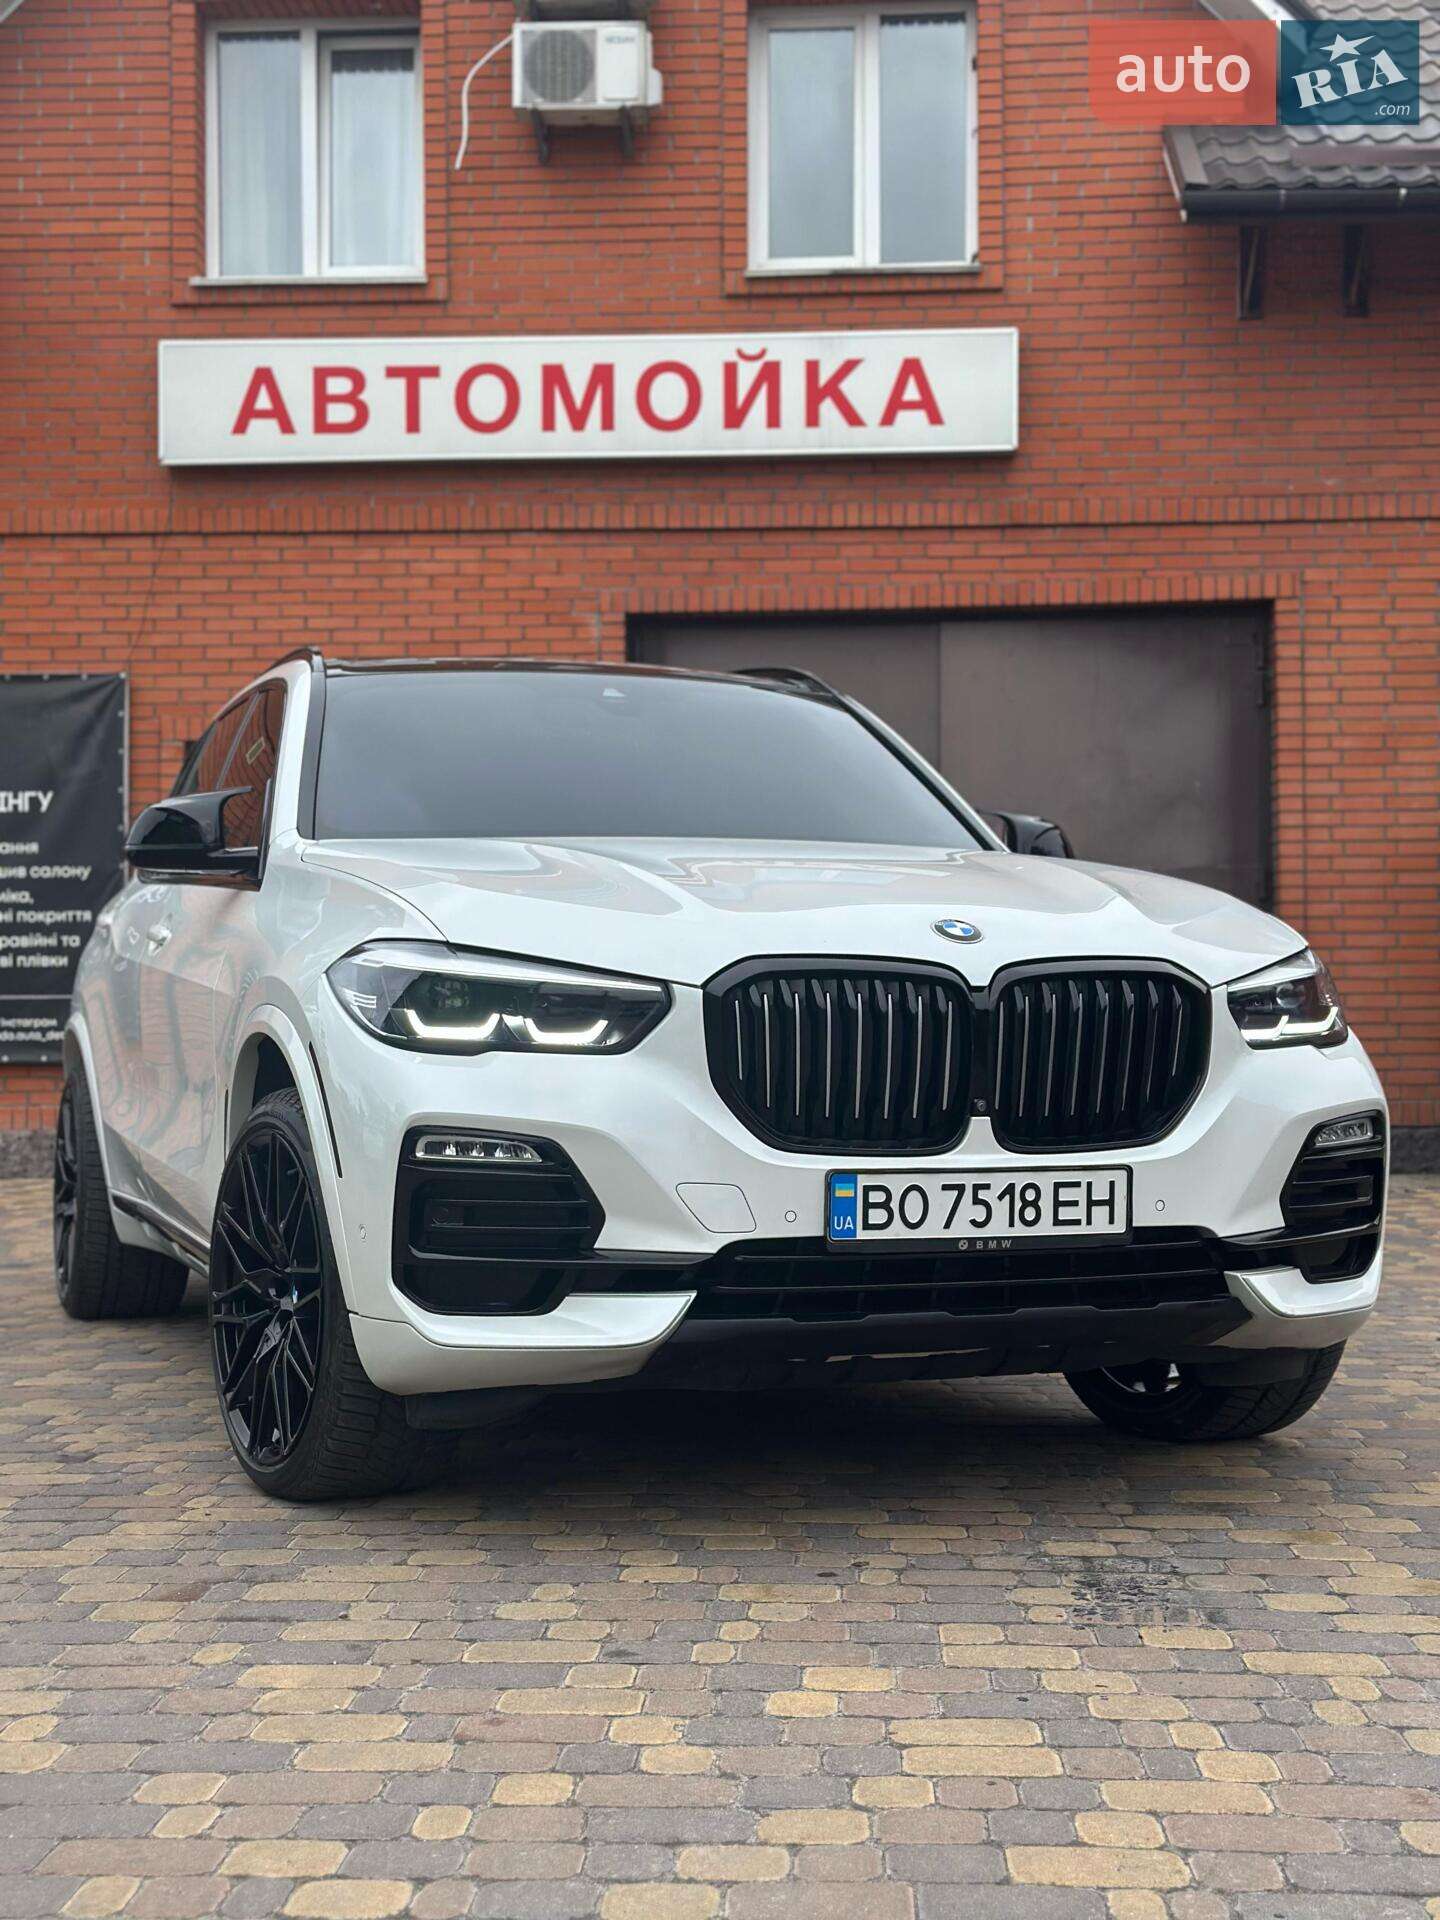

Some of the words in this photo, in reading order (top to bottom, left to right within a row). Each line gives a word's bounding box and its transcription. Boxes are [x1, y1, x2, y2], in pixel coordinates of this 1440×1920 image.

[232, 347, 946, 436] АВТОМОЙКА
[29, 865, 92, 881] салону
[16, 910, 92, 925] покриття
[61, 934, 81, 948] та
[16, 953, 68, 968] плівки
[861, 1183, 929, 1231] BO
[940, 1182, 1043, 1230] 7518
[1052, 1180, 1116, 1227] EH
[834, 1216, 854, 1230] UA
[976, 1239, 1012, 1249] BMW
